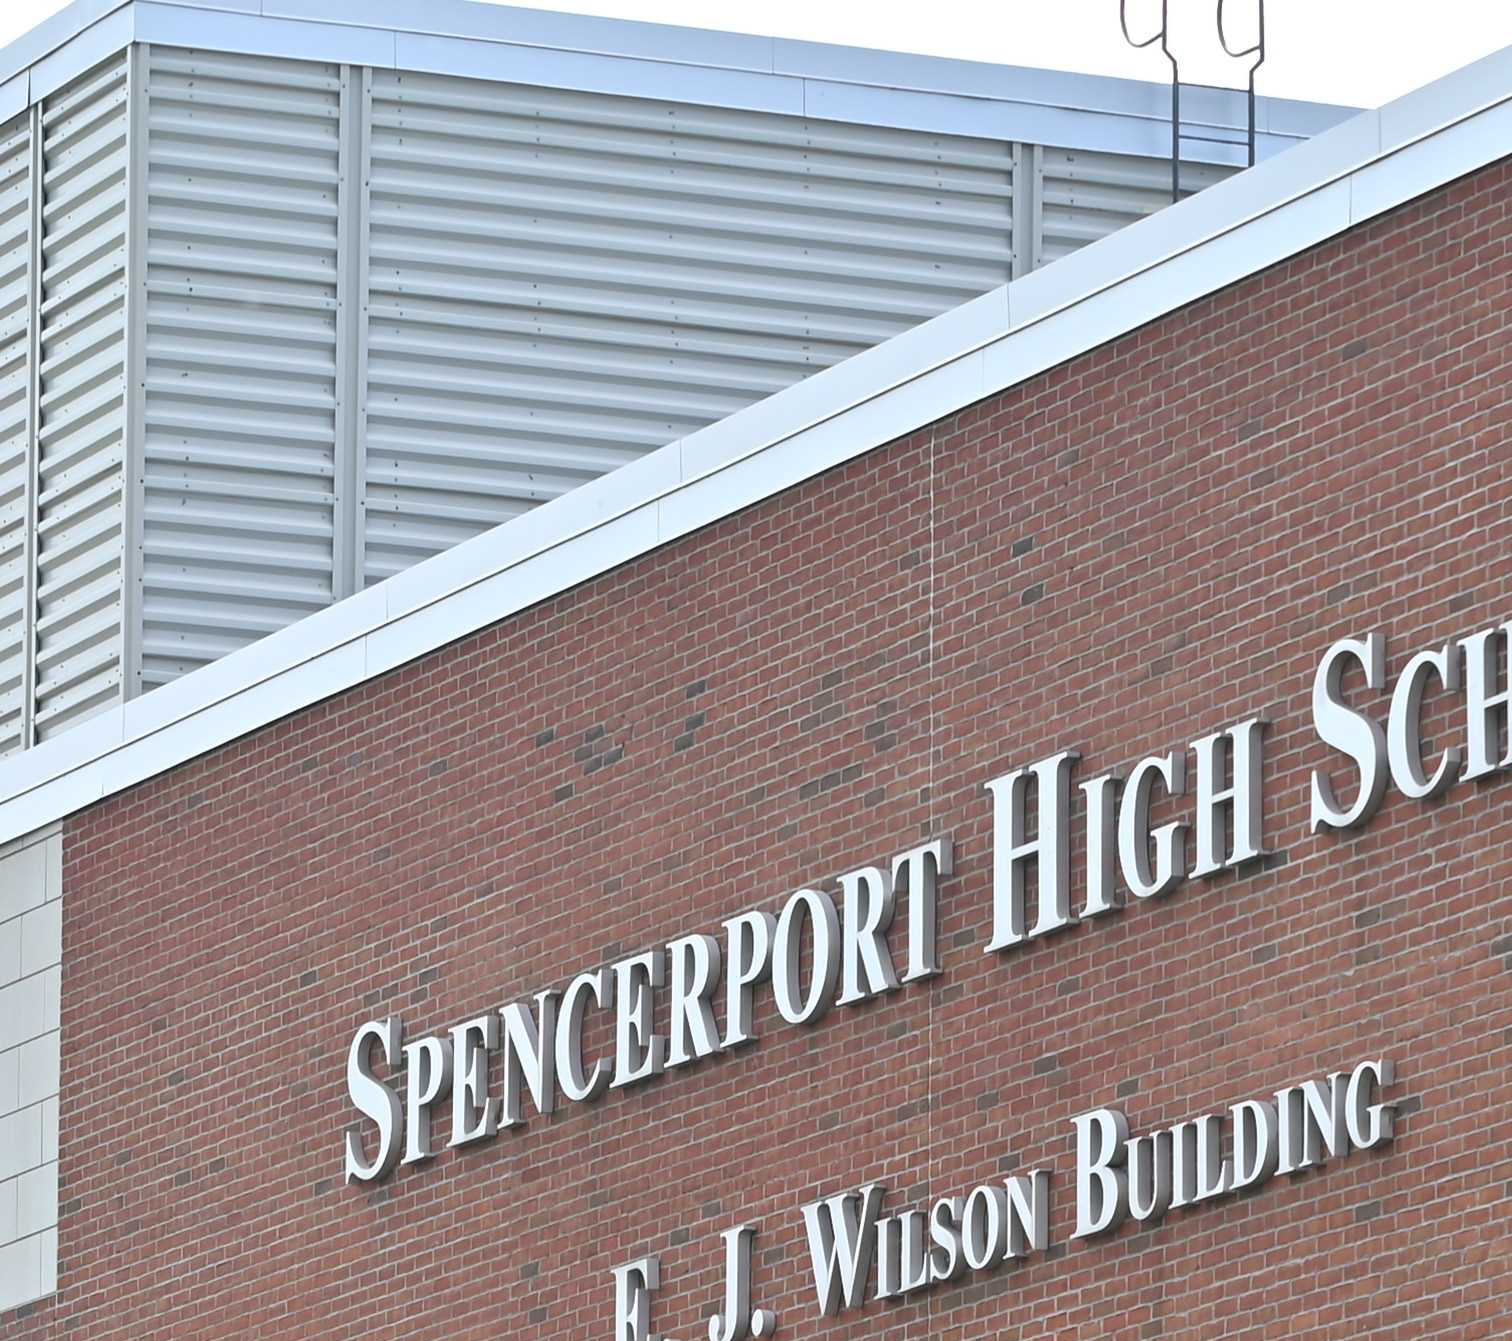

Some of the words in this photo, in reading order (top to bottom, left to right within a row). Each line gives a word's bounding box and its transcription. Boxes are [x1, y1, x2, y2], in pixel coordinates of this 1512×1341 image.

[344, 837, 952, 1184] SPENCERPORT
[983, 717, 1268, 954] HIGH
[802, 1169, 1049, 1317] WILSON
[1072, 1060, 1398, 1240] BUILDING
